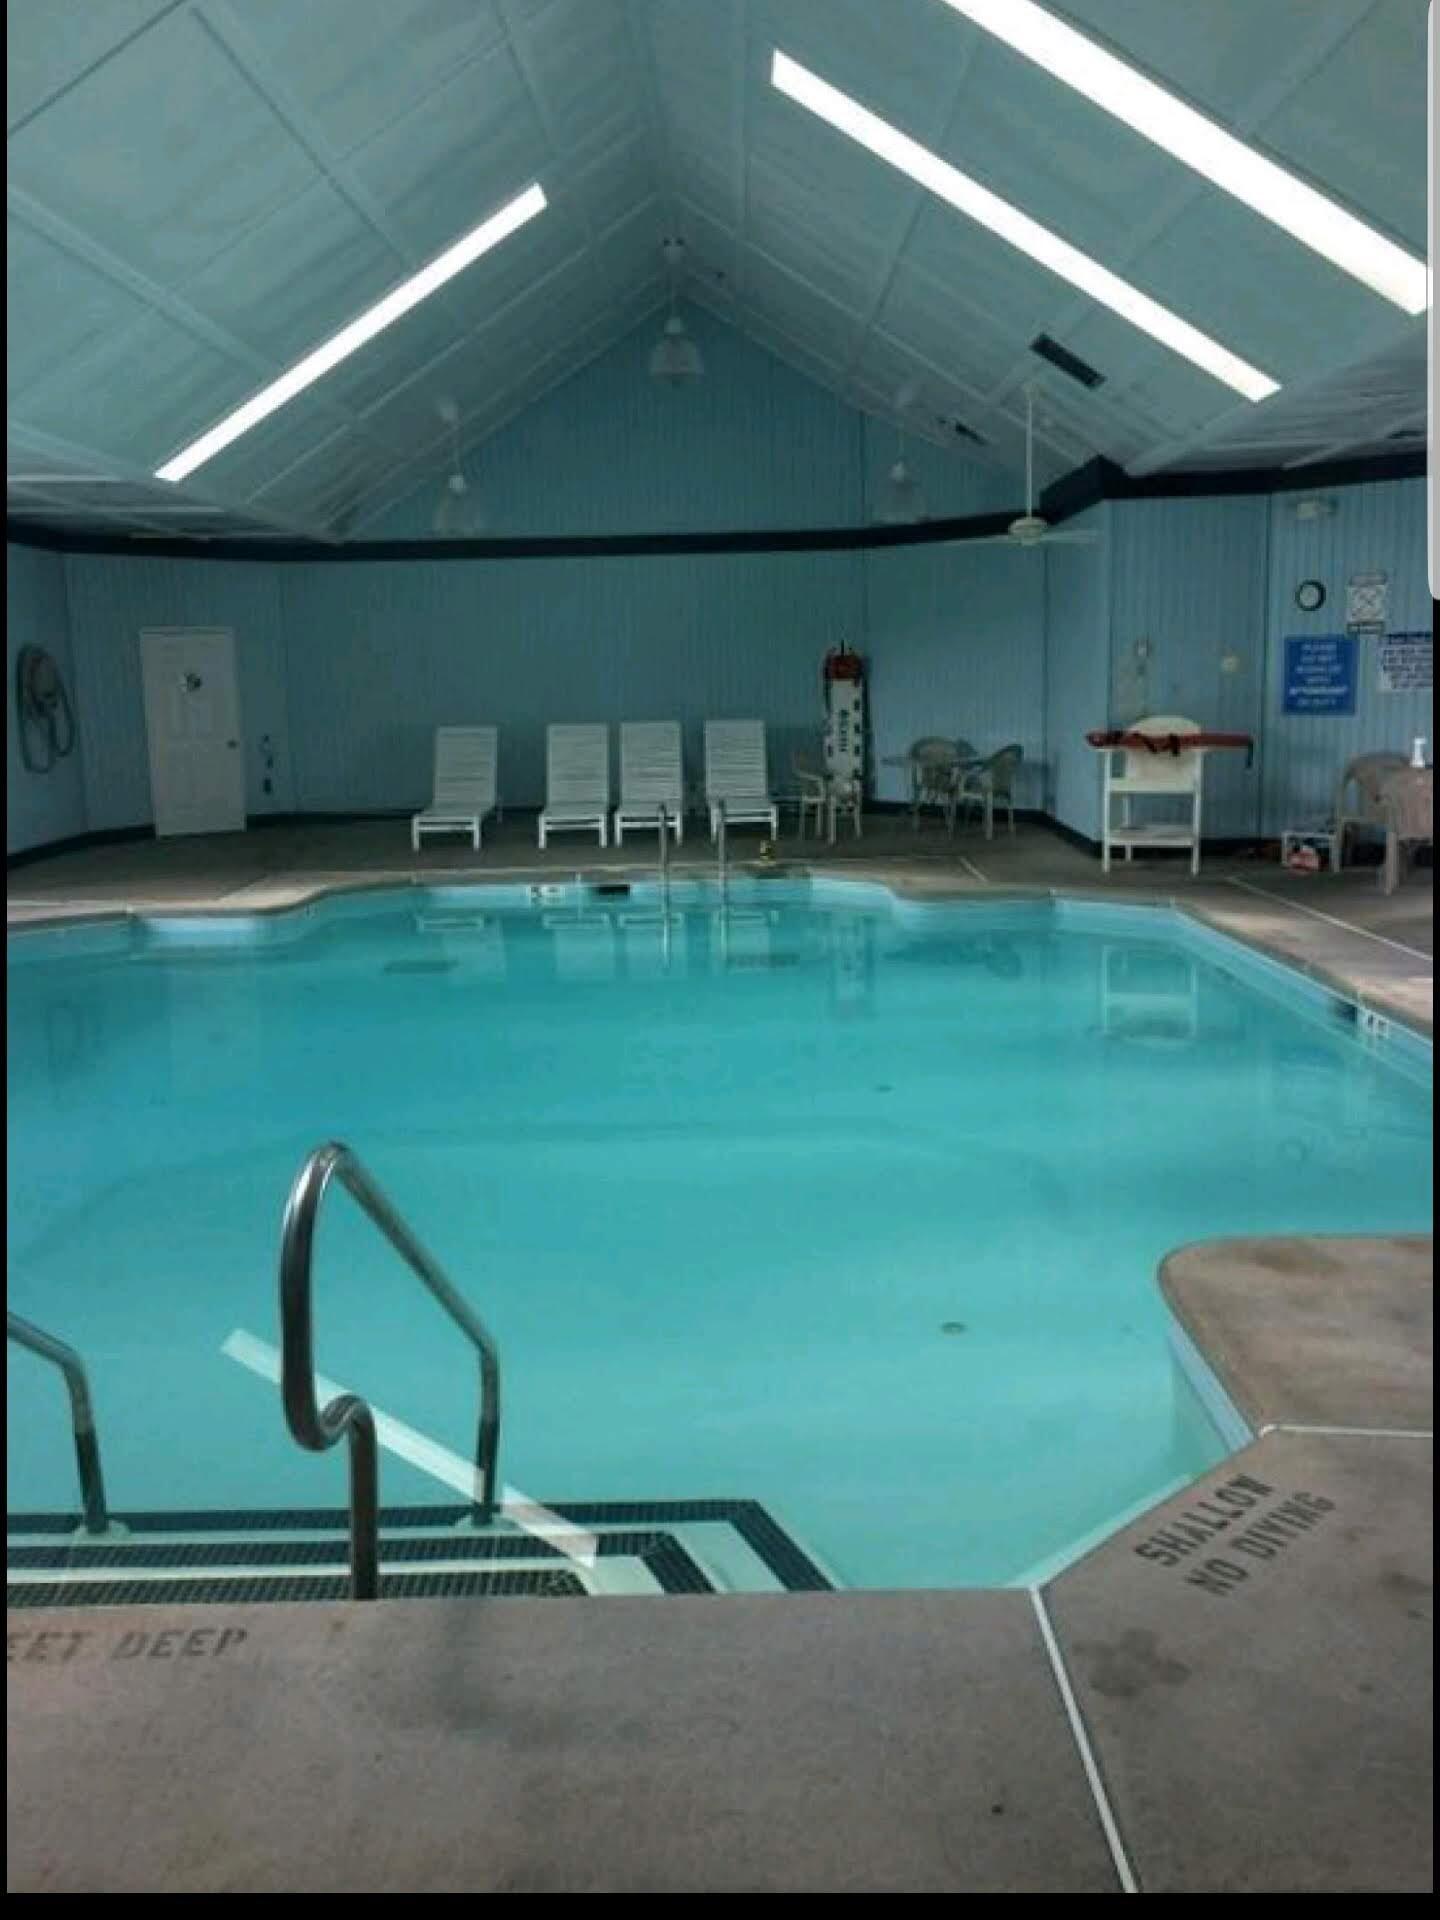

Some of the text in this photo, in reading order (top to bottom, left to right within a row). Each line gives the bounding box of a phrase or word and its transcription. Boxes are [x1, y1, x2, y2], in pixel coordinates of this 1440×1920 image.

[1133, 1472, 1274, 1567] SHALLOW
[1184, 1490, 1337, 1597] NO DIVING
[109, 1627, 248, 1660] DEEP
